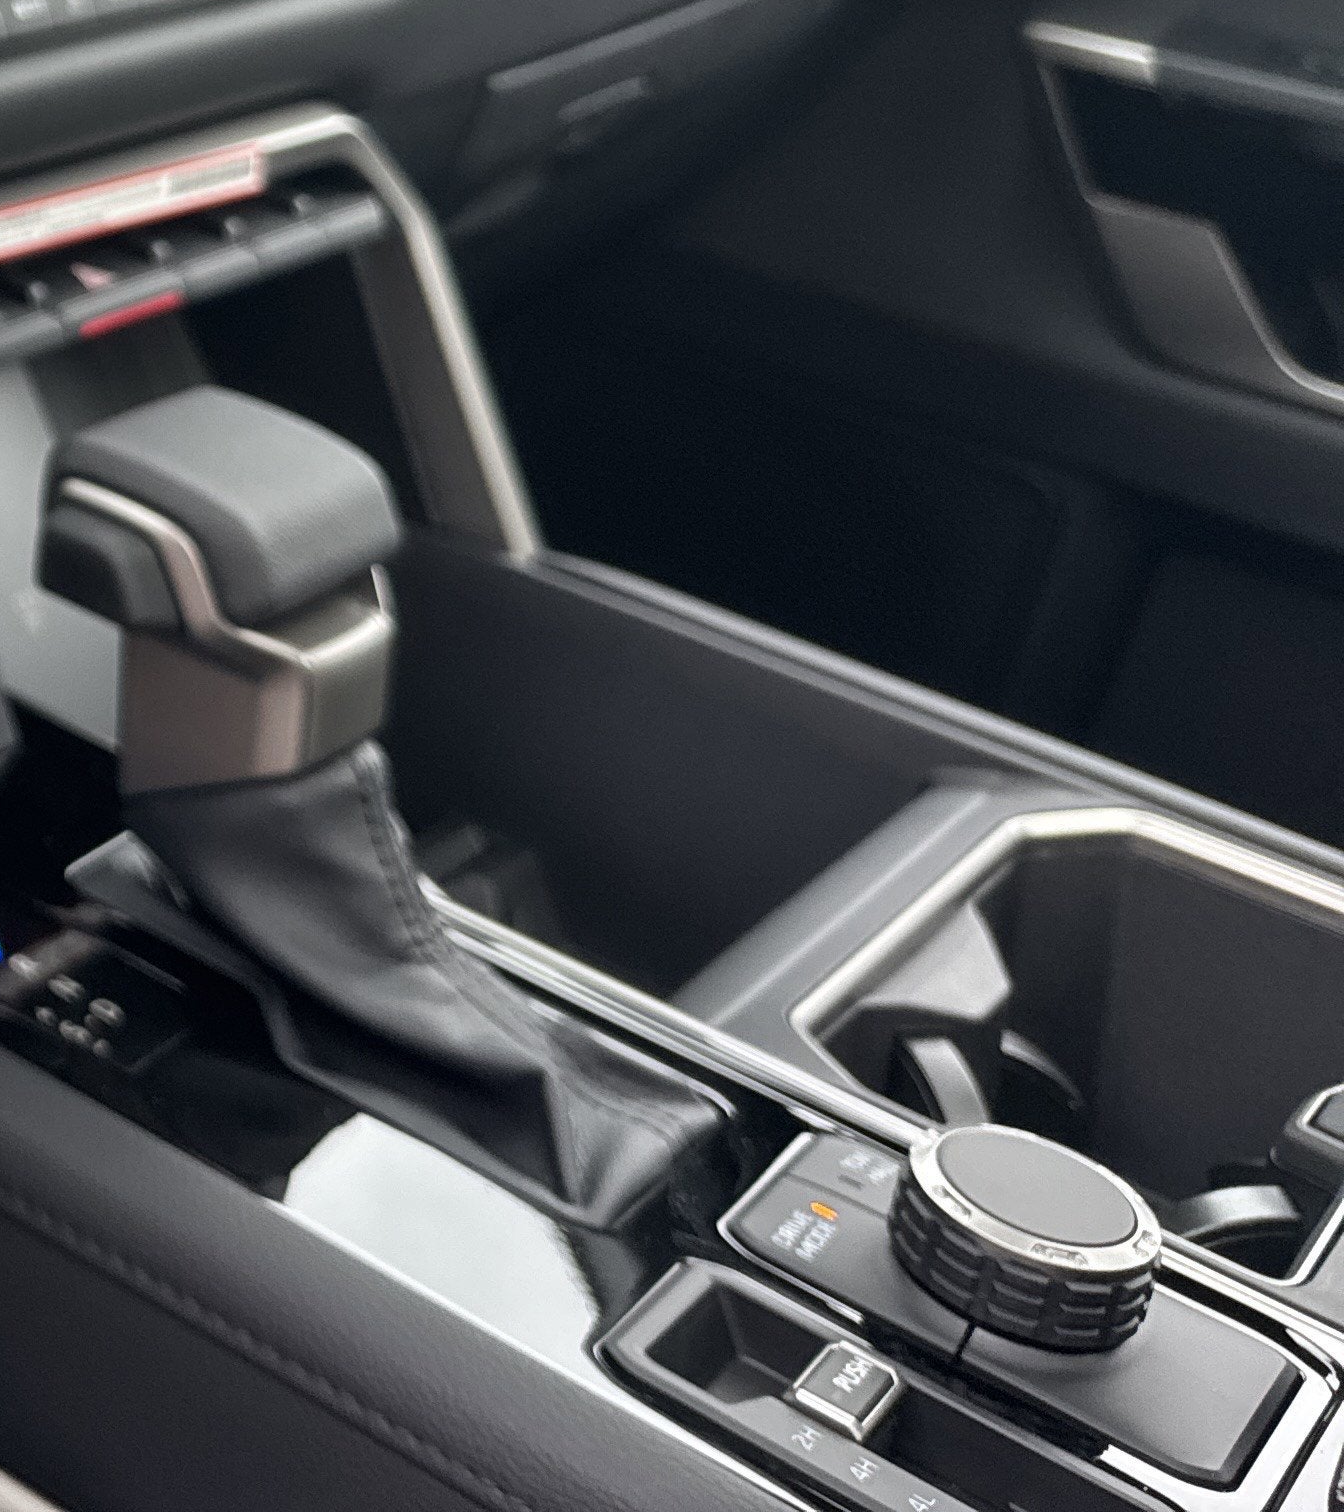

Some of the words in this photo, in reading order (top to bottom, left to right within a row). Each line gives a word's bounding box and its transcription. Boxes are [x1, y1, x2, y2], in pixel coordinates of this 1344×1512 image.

[832, 1355, 874, 1393] PUSH
[791, 1425, 823, 1452] 2H
[849, 1456, 881, 1482] 4H
[908, 1492, 938, 1512] 4L
